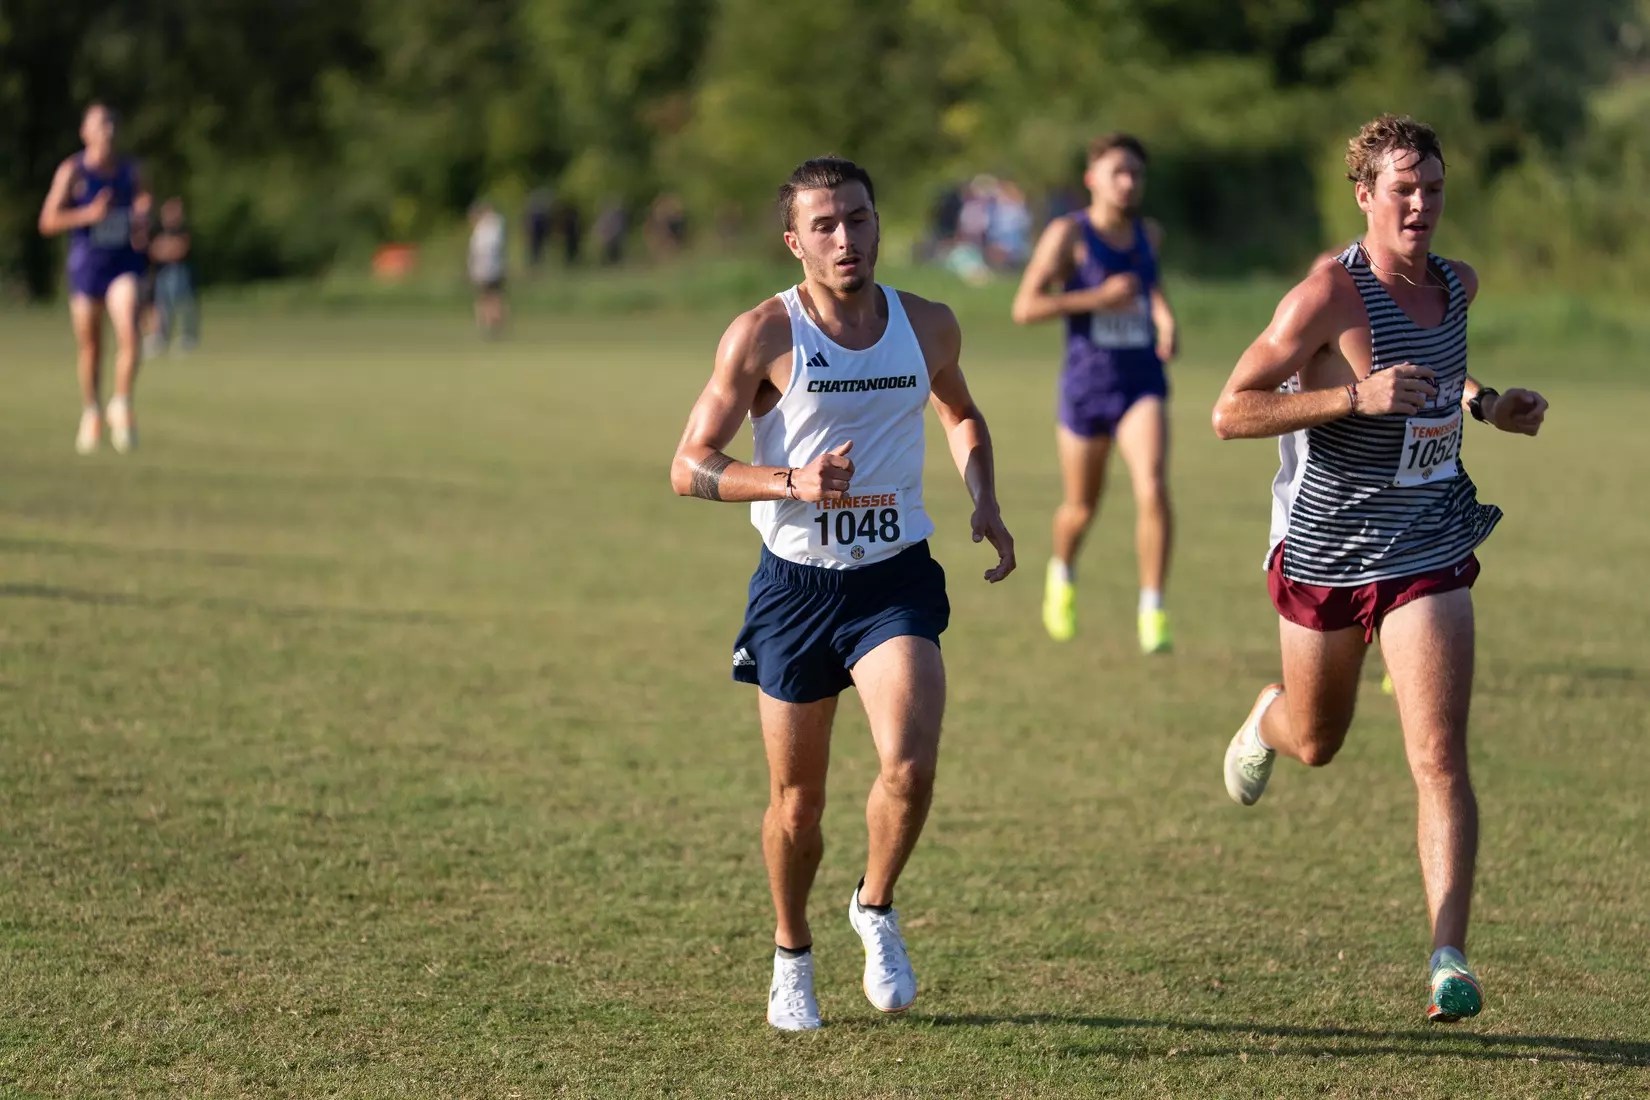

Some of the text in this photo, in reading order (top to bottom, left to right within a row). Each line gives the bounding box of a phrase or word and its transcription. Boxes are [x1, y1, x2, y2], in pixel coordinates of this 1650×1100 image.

[807, 375, 917, 393] CHATTANOOGA
[1408, 430, 1458, 469] 1052
[816, 493, 897, 510] TENNESSEE
[814, 508, 900, 545] 1048
